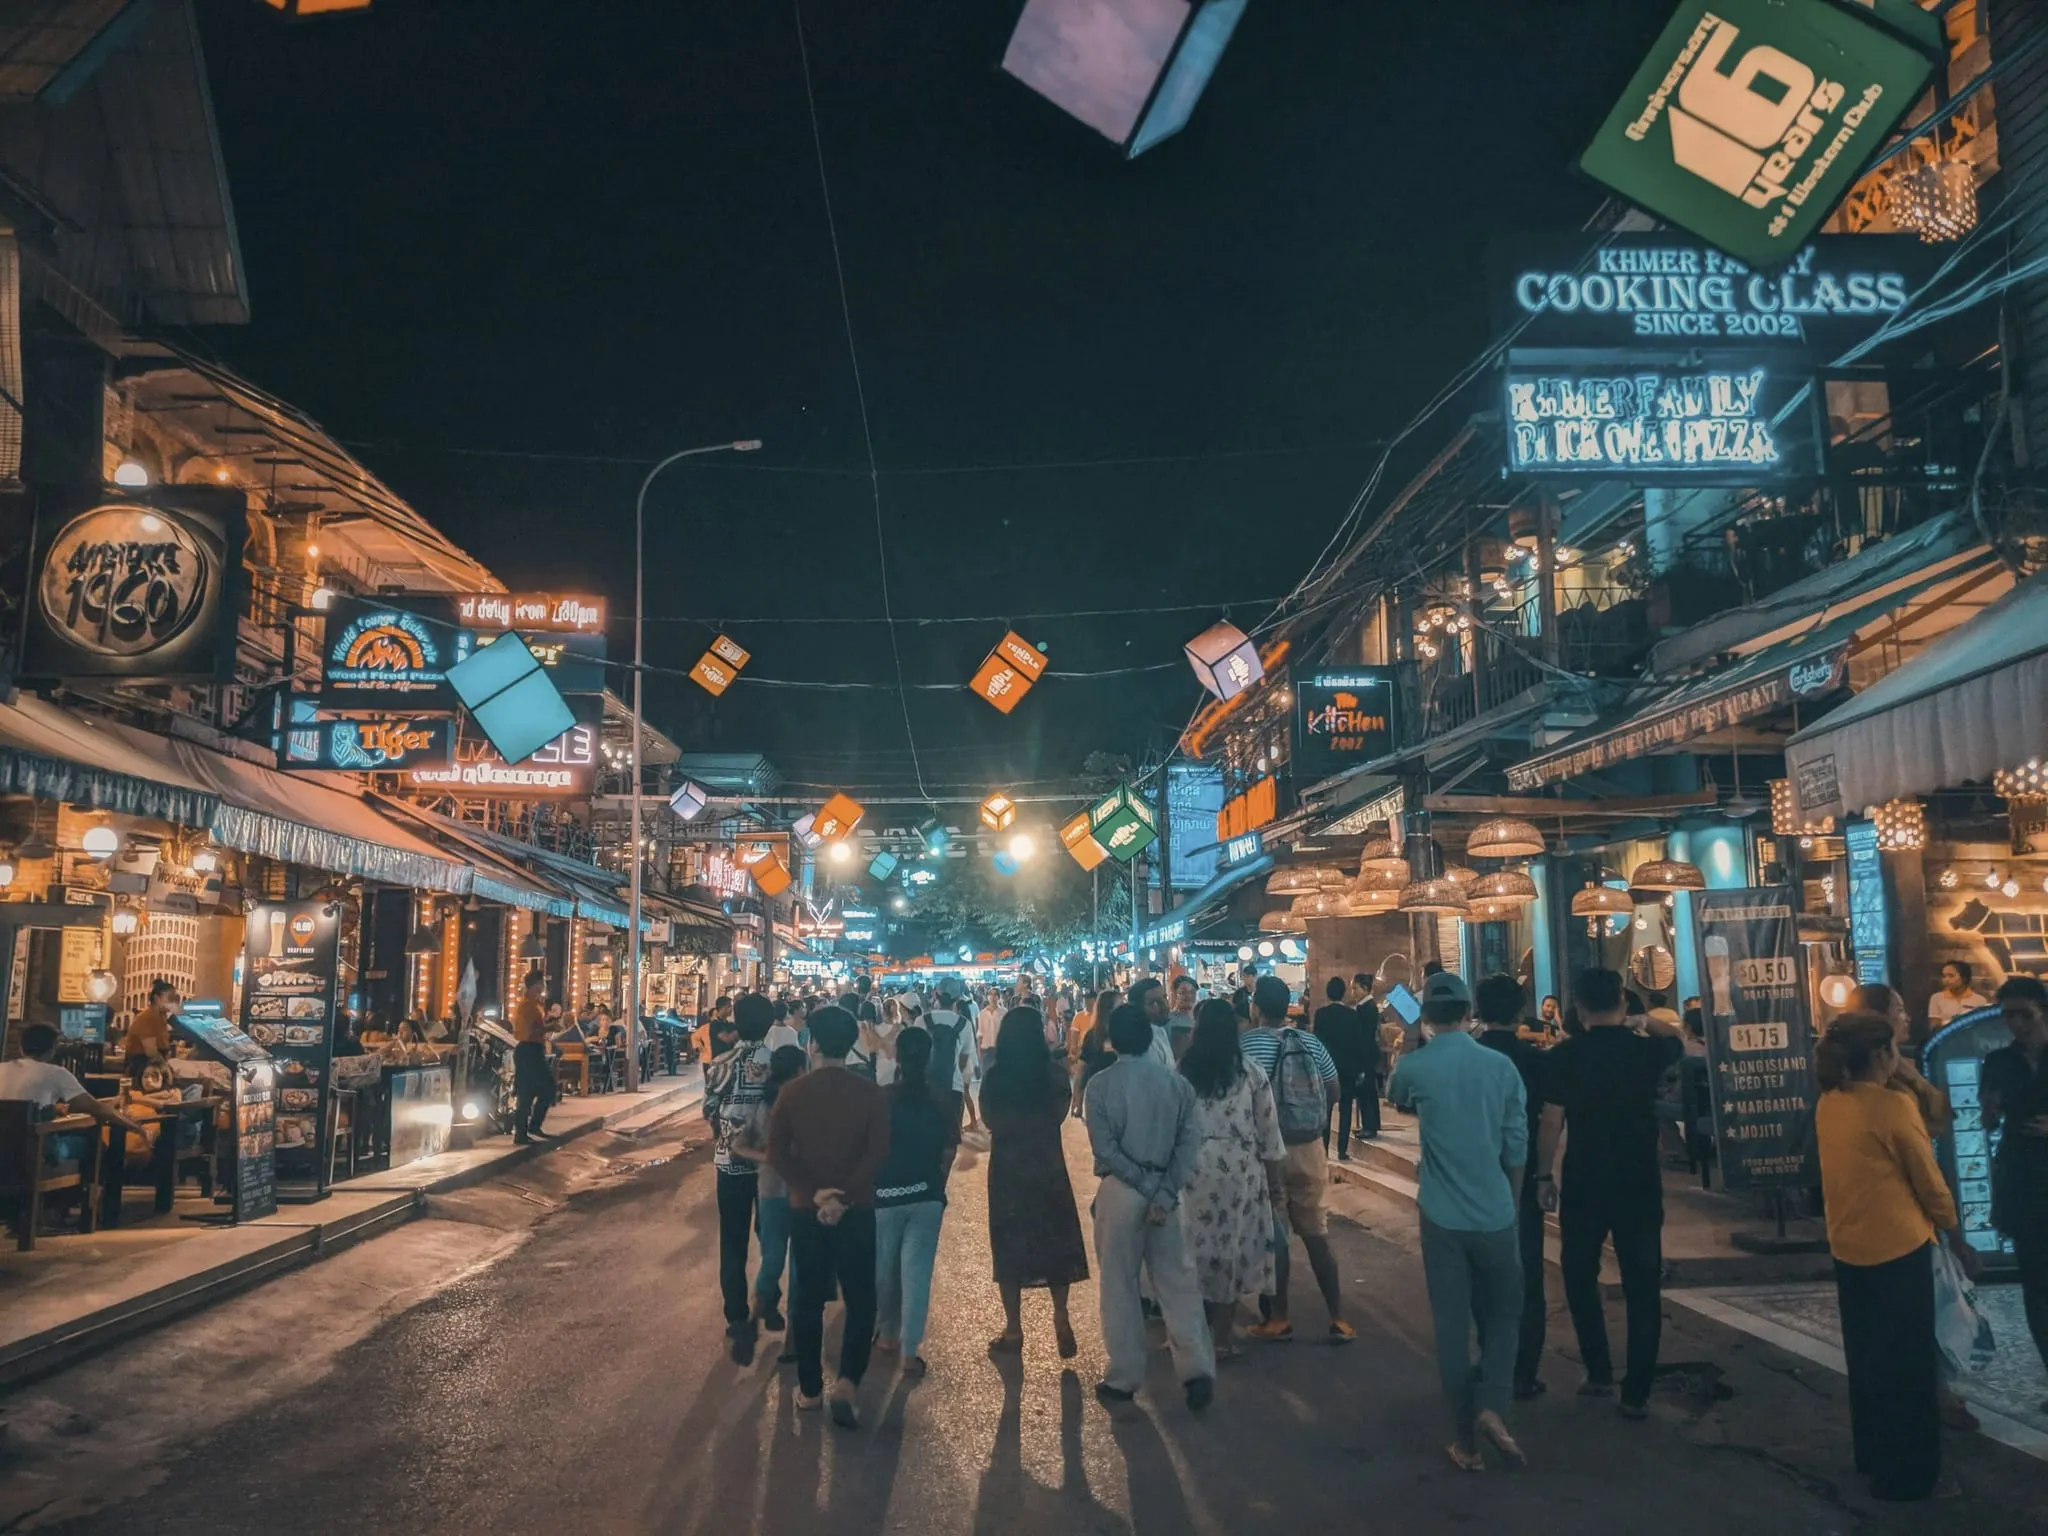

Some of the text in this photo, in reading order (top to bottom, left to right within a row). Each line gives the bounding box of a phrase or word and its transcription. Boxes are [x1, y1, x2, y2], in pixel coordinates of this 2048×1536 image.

[1668, 20, 1815, 198] 16
[1787, 123, 1855, 206] Western
[1843, 83, 1884, 134] Club
[1599, 246, 1817, 275] KHMER FAY
[1516, 273, 1908, 315] COOKING CLASS
[1634, 313, 1799, 336] SINCE 2002
[1684, 417, 1779, 463] PIZZA
[65, 569, 179, 643] 1960
[477, 599, 511, 626] daily
[514, 599, 547, 620] from
[327, 671, 446, 681] Wood Fired Pizza
[359, 721, 436, 760] Tiger
[1739, 961, 1788, 984] $0.50
[1737, 1027, 1780, 1048] $1.75
[1732, 1056, 1807, 1075] LONG ISLAND
[1734, 1074, 1785, 1091] ICED TEA
[1737, 1096, 1806, 1115] MARGARITA
[1740, 1123, 1783, 1140] MOJITO
